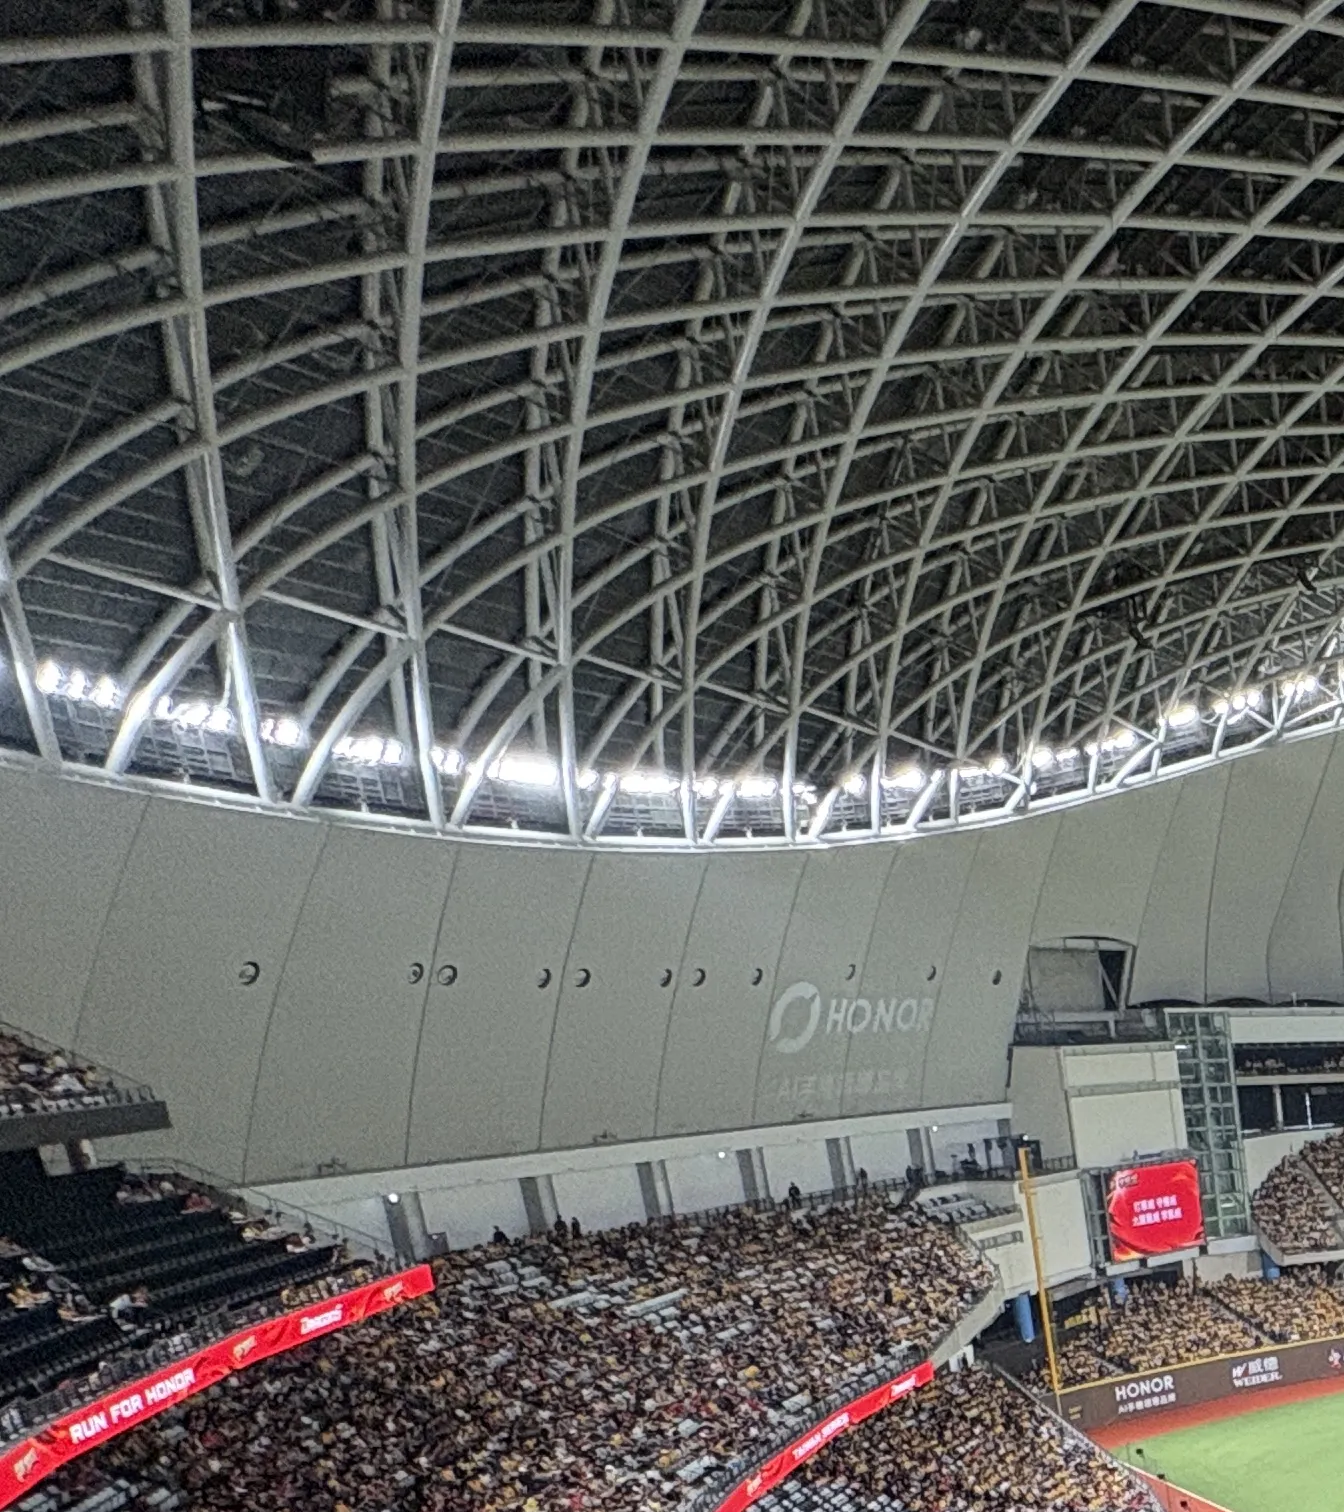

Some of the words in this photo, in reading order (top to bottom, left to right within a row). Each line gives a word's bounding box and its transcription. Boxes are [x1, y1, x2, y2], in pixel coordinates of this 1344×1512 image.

[826, 998, 934, 1034] HONOR
[70, 1412, 108, 1444] RUN
[110, 1397, 145, 1423] FOR
[145, 1367, 197, 1402] HONOR
[1114, 1375, 1175, 1402] HONOR
